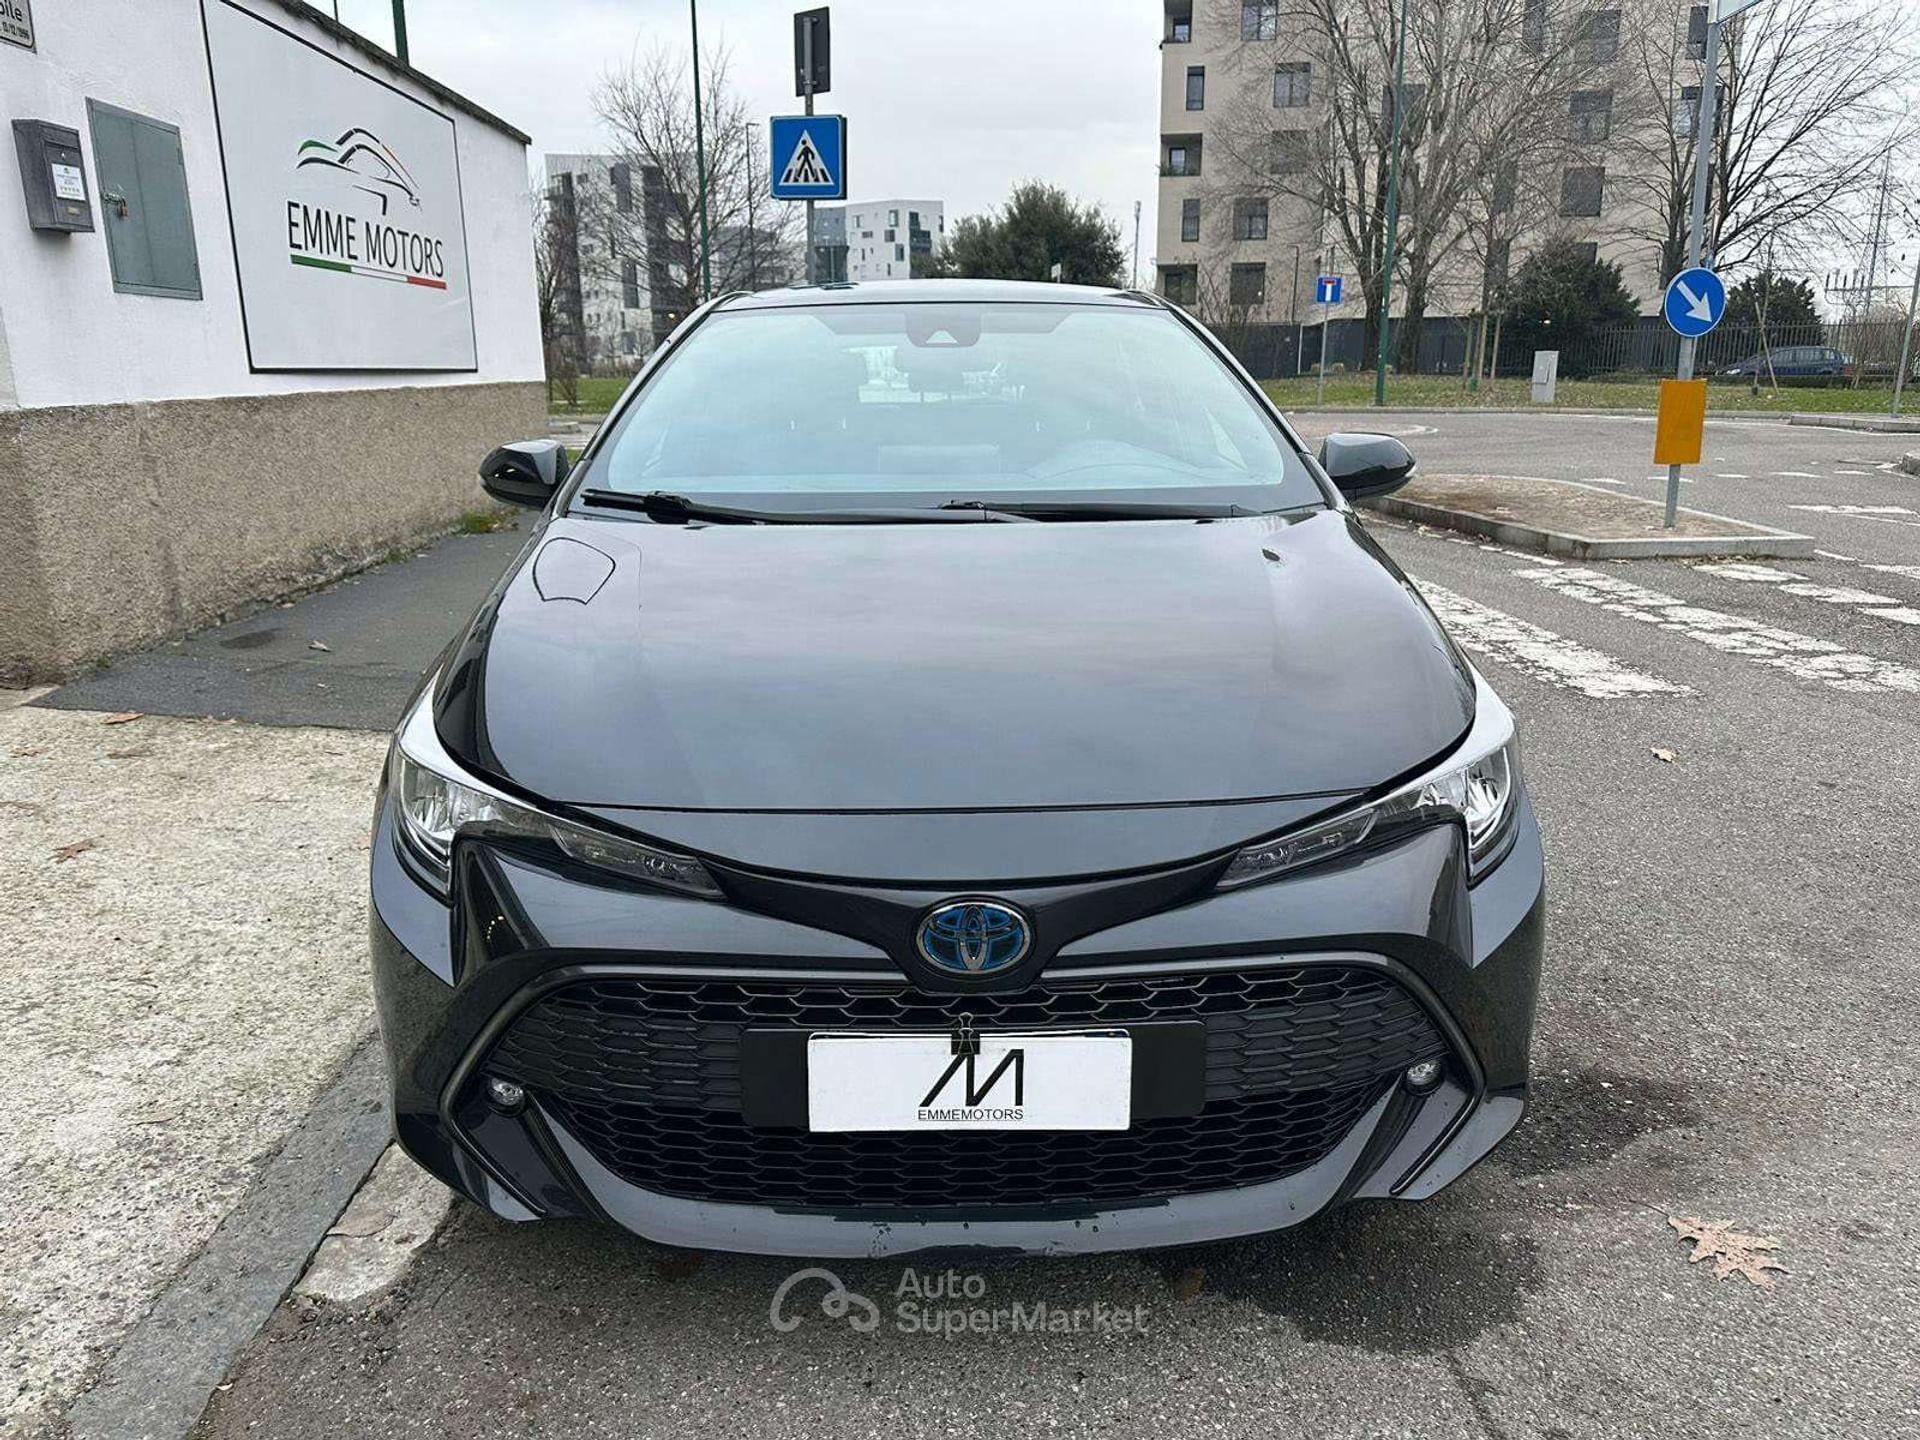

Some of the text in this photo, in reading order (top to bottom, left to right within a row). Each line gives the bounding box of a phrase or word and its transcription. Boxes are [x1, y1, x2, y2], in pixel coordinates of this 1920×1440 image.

[287, 201, 444, 277] EMME MOTORS
[918, 1109, 1024, 1120] EMMEMOTORS
